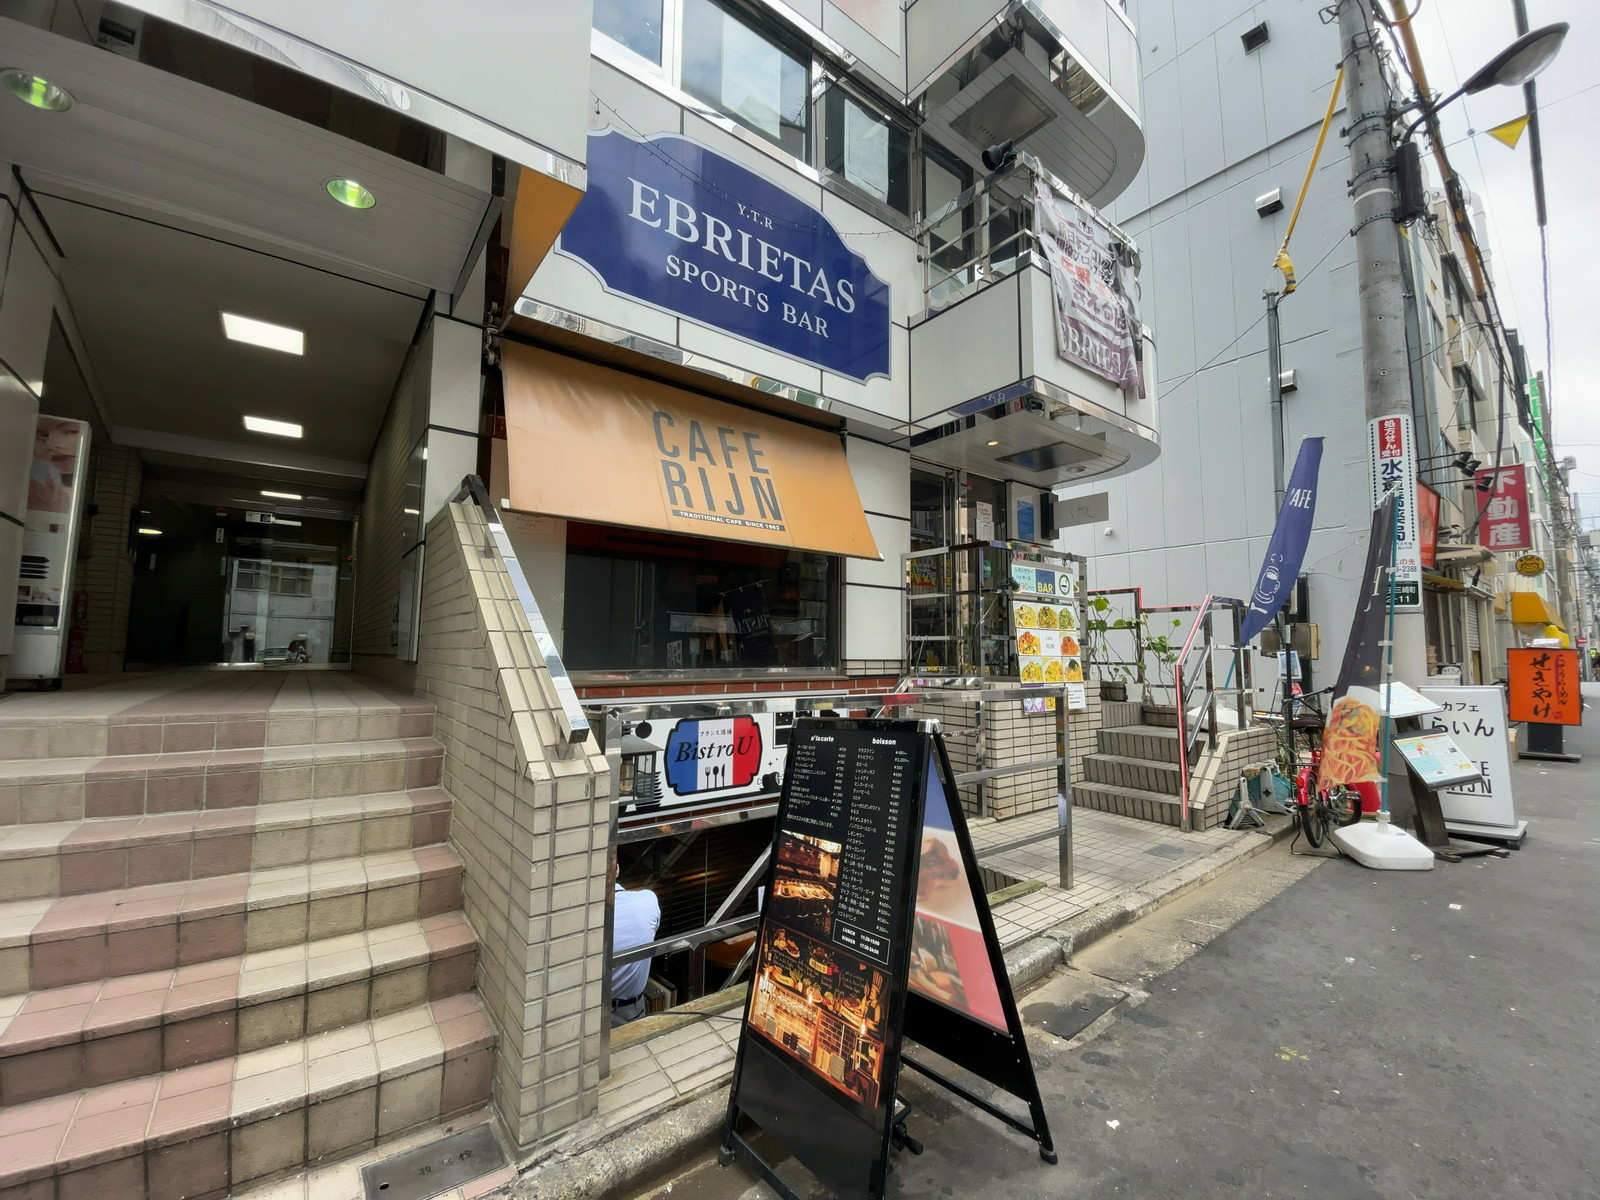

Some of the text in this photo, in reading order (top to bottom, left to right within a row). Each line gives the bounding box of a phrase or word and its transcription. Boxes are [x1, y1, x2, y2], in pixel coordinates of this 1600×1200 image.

[737, 202, 774, 230] Y.T.R
[627, 176, 856, 314] EBRIETAS
[666, 254, 829, 338] SPORTS BAR
[652, 410, 770, 475] CAFE
[661, 459, 783, 522] RIJN
[679, 511, 725, 524] TRADITIONAL
[726, 518, 743, 526] CAFE
[745, 520, 764, 529] SINCE
[1487, 468, 1522, 548] 不動産
[1037, 582, 1054, 594] BAR
[1441, 702, 1480, 713] カフェ
[699, 727, 733, 738] フランス酒場
[1432, 716, 1495, 737] らいん
[872, 737, 897, 746] boisson
